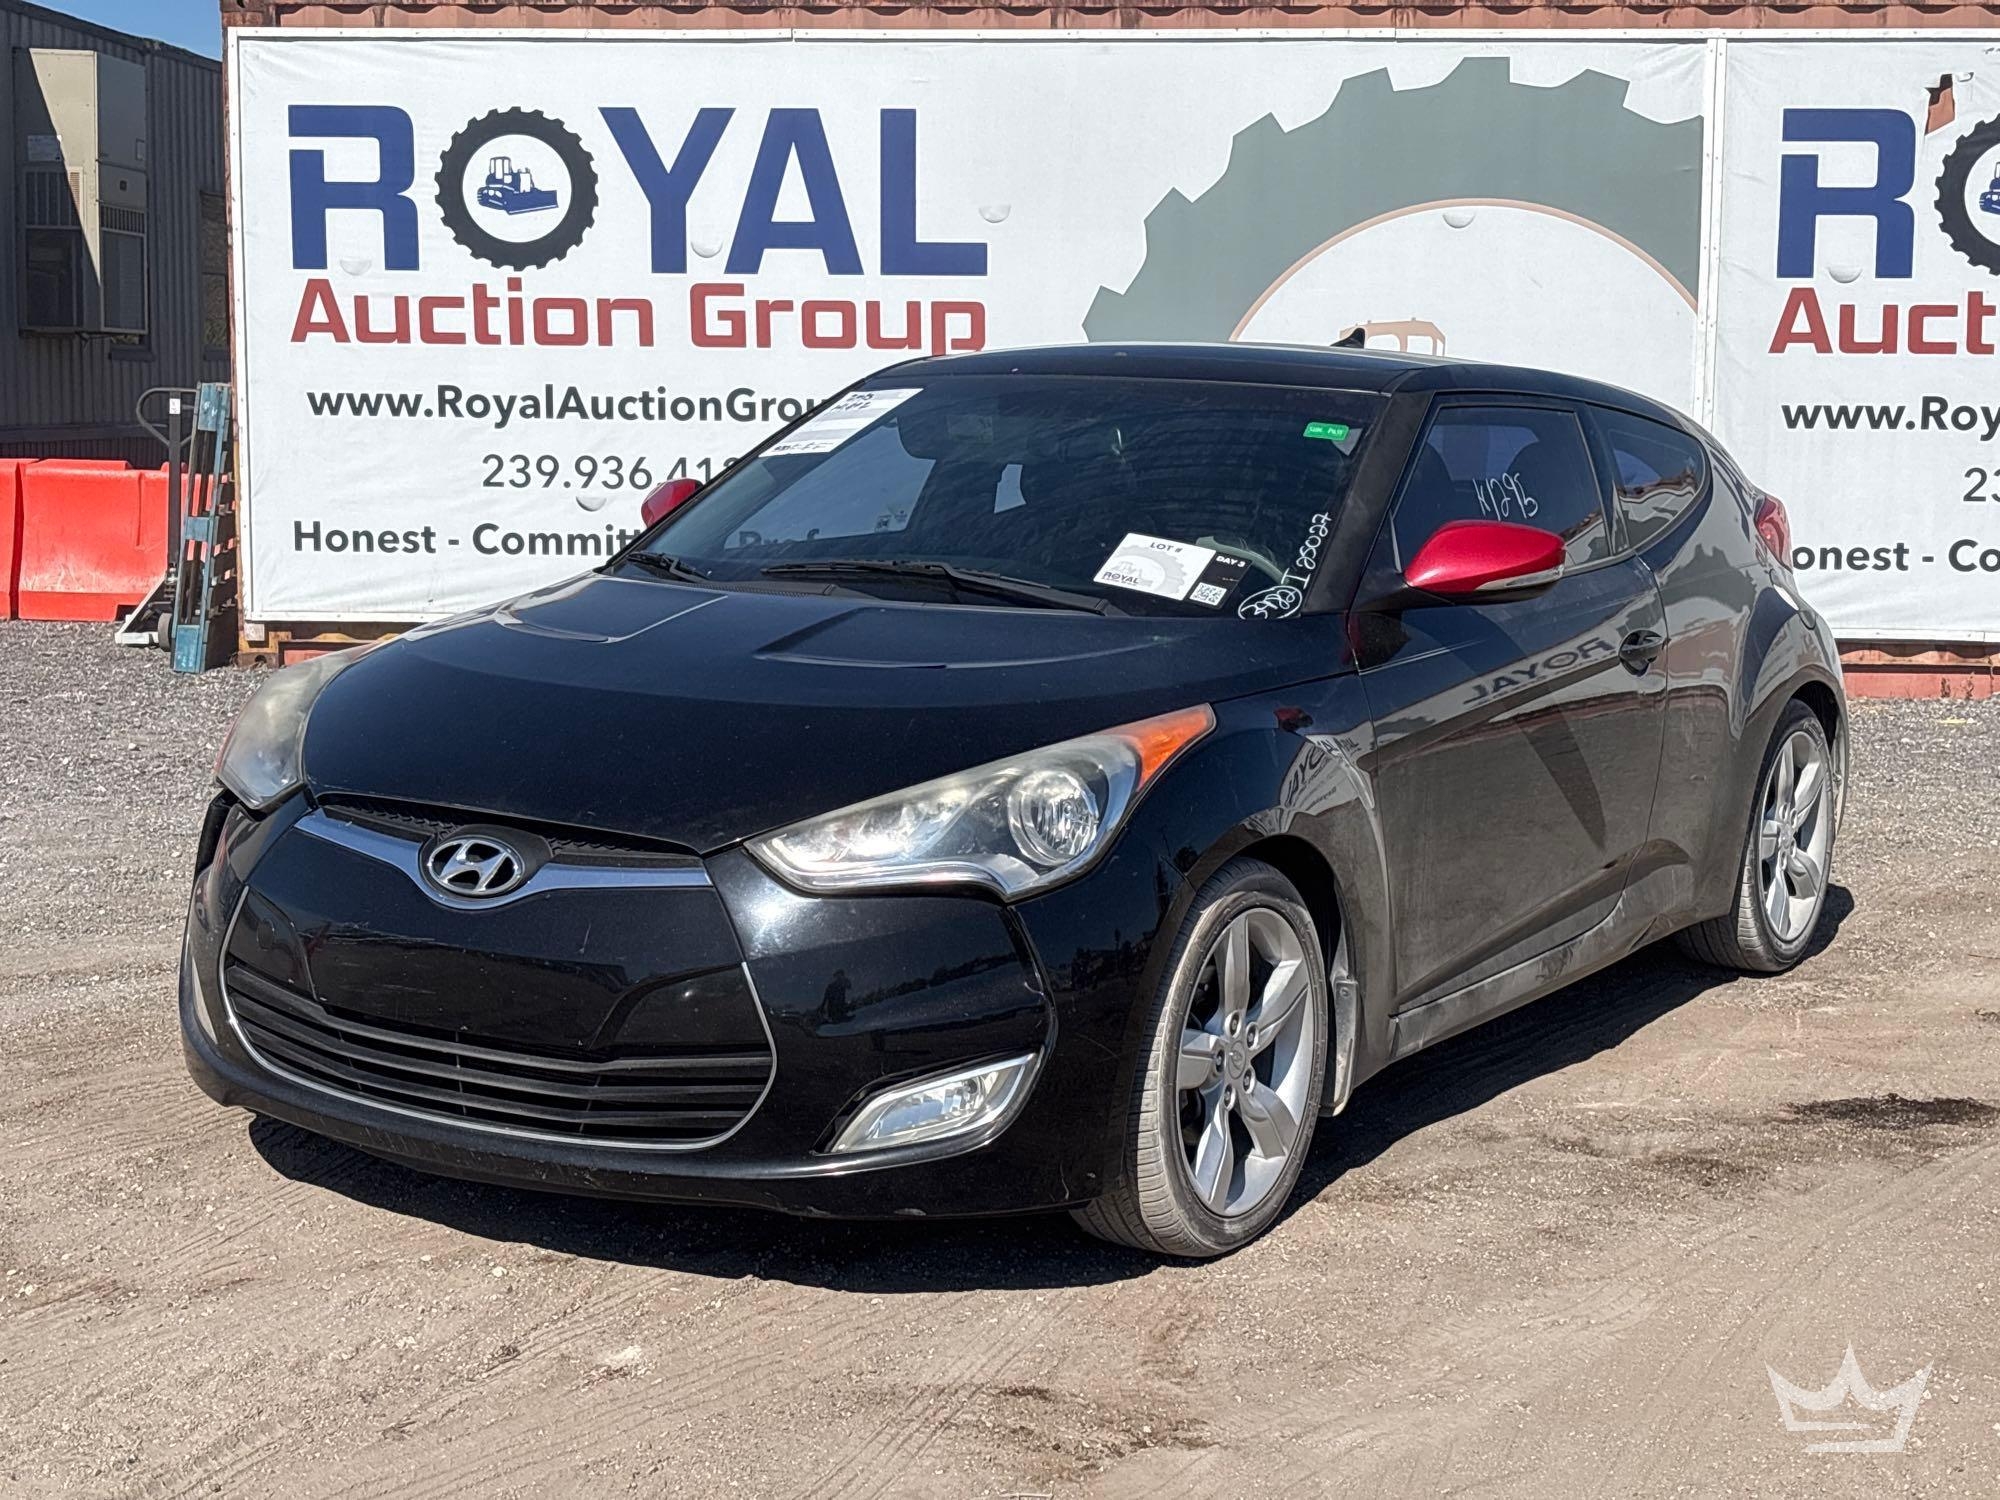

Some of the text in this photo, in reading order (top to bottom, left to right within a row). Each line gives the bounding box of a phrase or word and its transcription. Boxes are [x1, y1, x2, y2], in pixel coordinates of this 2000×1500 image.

[288, 104, 988, 277] ROYAL
[290, 278, 987, 356] Auction Group
[1768, 287, 1997, 355] Auct
[1781, 395, 2000, 442] www.Roy
[294, 520, 436, 554] Honest
[1150, 542, 1174, 551] LOT
[1216, 555, 1238, 565] DAY
[1949, 538, 2000, 573] Co
[1103, 571, 1139, 584] ROYAL
